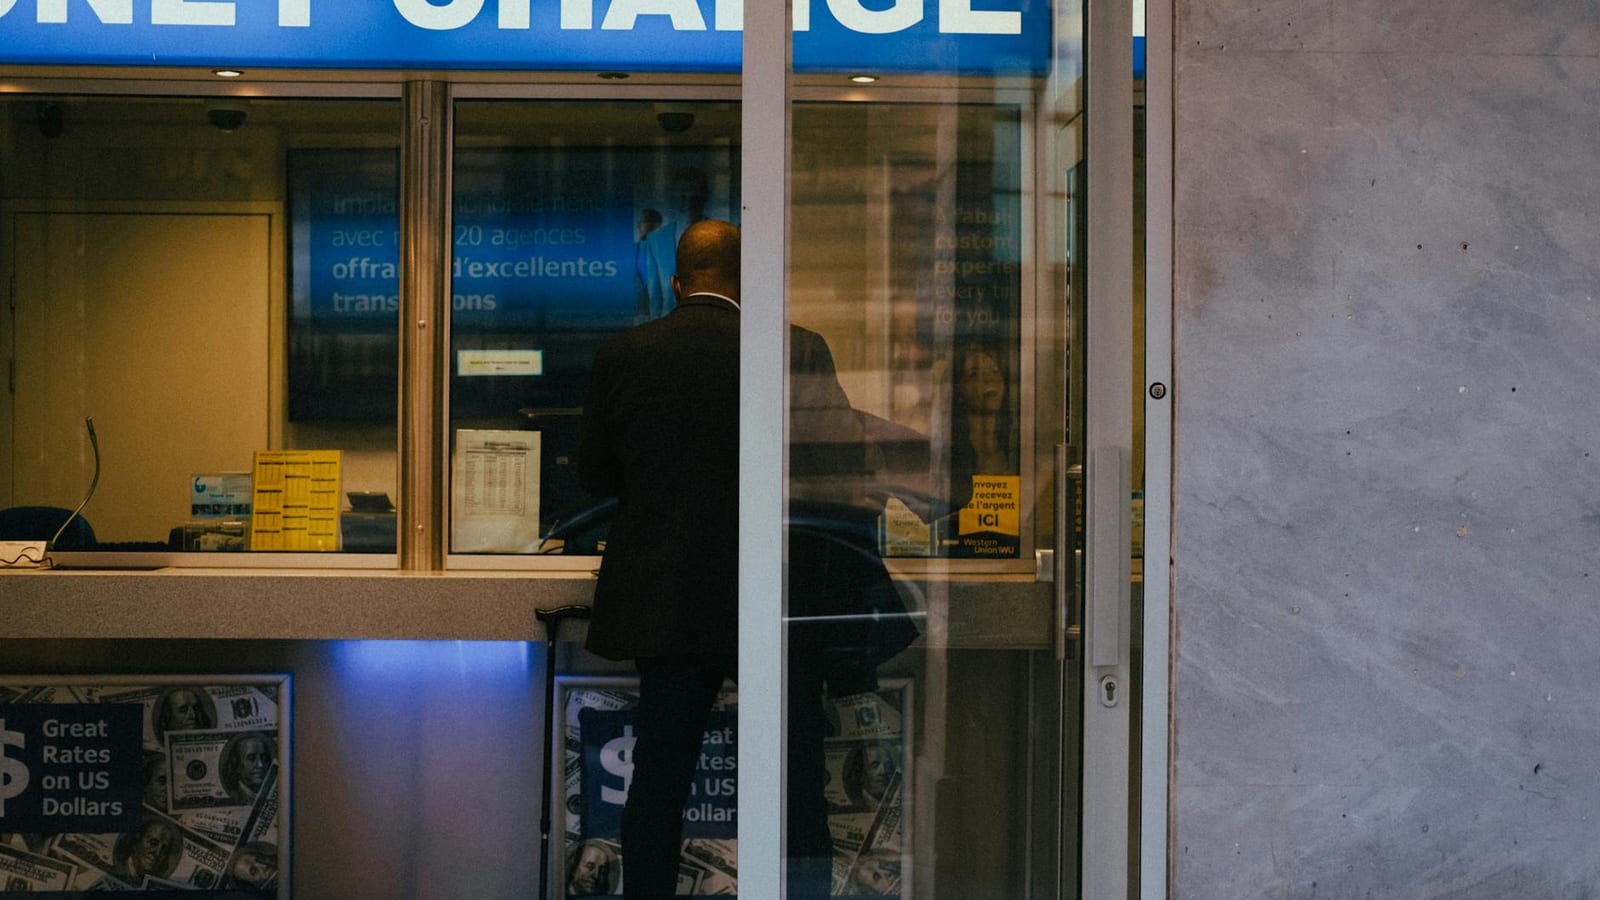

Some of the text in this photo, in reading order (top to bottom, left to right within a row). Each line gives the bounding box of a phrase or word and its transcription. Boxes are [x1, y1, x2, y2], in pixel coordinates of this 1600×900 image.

[332, 229, 384, 246] avec
[491, 229, 585, 248] agences
[332, 257, 397, 279] offra
[974, 482, 1008, 490] nvoyez
[977, 501, 1015, 511] l'argent
[978, 513, 999, 527] ICI
[963, 538, 998, 546] Western
[974, 546, 998, 554] Union
[42, 719, 108, 737] Great
[42, 745, 111, 764] Rates
[41, 771, 110, 790] on US
[704, 778, 736, 796] US
[42, 797, 123, 816] Dollars
[682, 803, 736, 822] ollar
